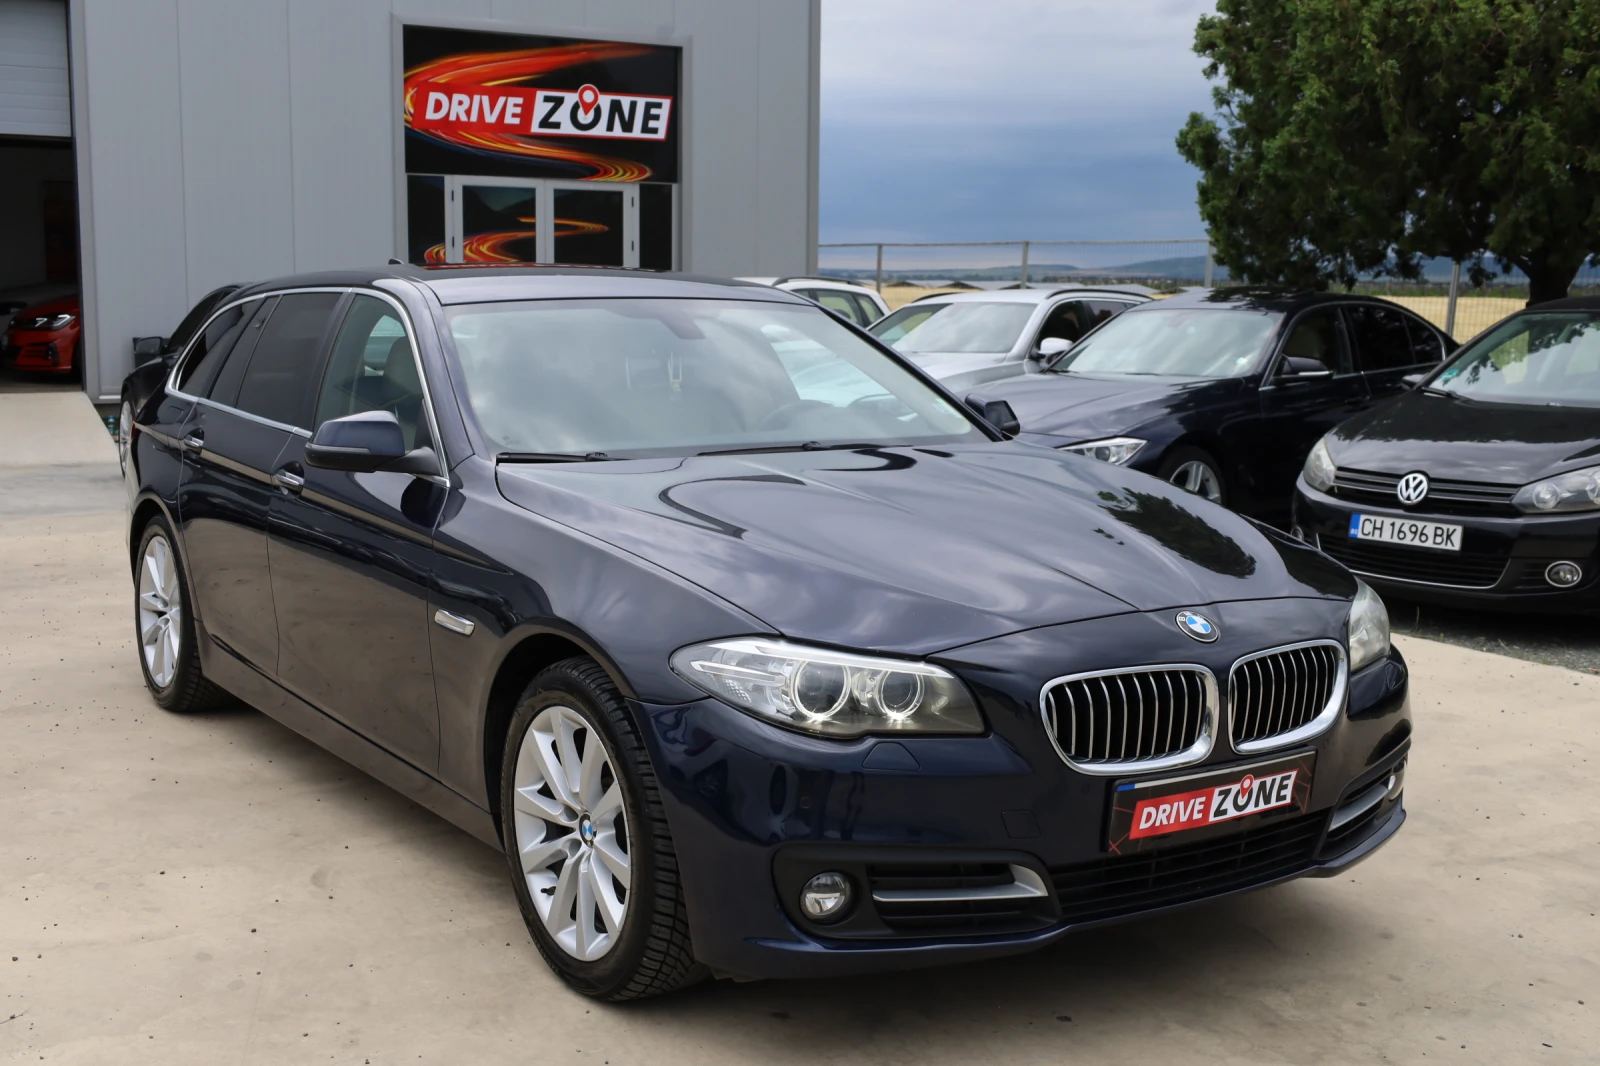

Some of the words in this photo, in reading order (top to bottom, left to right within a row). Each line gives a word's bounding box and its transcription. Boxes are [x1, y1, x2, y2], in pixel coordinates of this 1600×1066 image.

[424, 91, 525, 125] DRIVE
[537, 94, 664, 135] ZONE
[1361, 518, 1385, 539] CH
[1389, 521, 1429, 544] 1696
[1432, 526, 1457, 548] BK
[1138, 796, 1207, 830] DRIVE
[1213, 773, 1293, 818] ZONE
